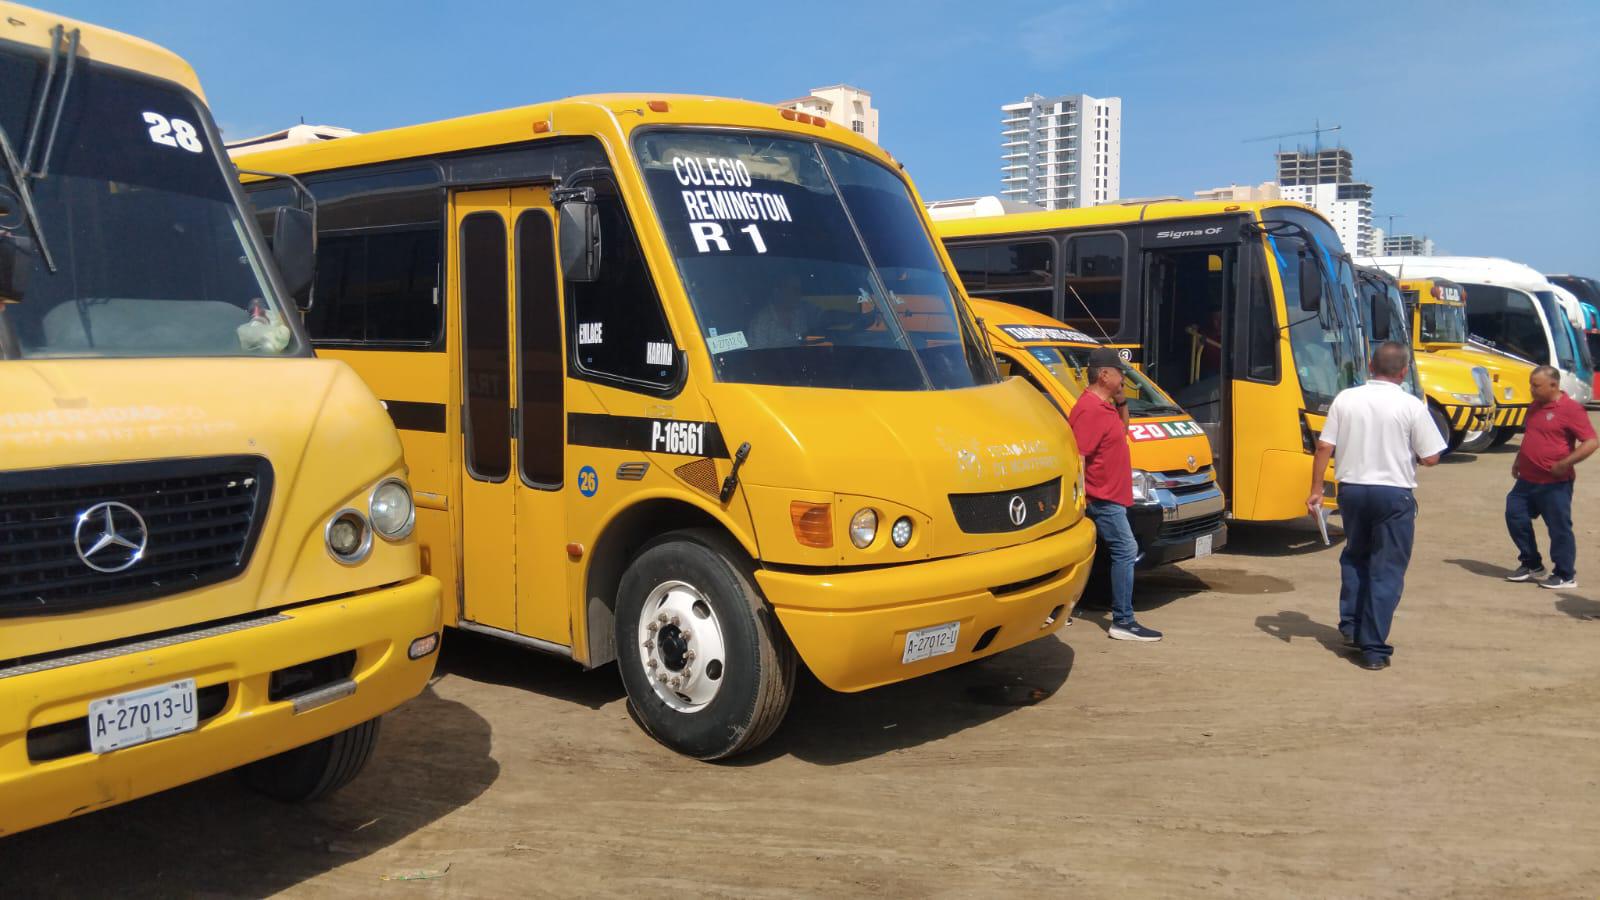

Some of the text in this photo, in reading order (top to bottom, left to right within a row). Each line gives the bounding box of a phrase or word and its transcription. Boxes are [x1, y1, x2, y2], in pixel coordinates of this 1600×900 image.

[142, 111, 204, 154] 28
[672, 156, 751, 188] COLEGIO
[682, 190, 793, 223] REMINGTON
[689, 222, 768, 254] R 1
[1156, 229, 1204, 240] Sigma
[579, 322, 603, 345] ENLACE
[651, 420, 704, 455] P-16561
[579, 471, 596, 492] 26
[907, 629, 958, 655] A-27012-U
[96, 692, 193, 738] A-27013-U
